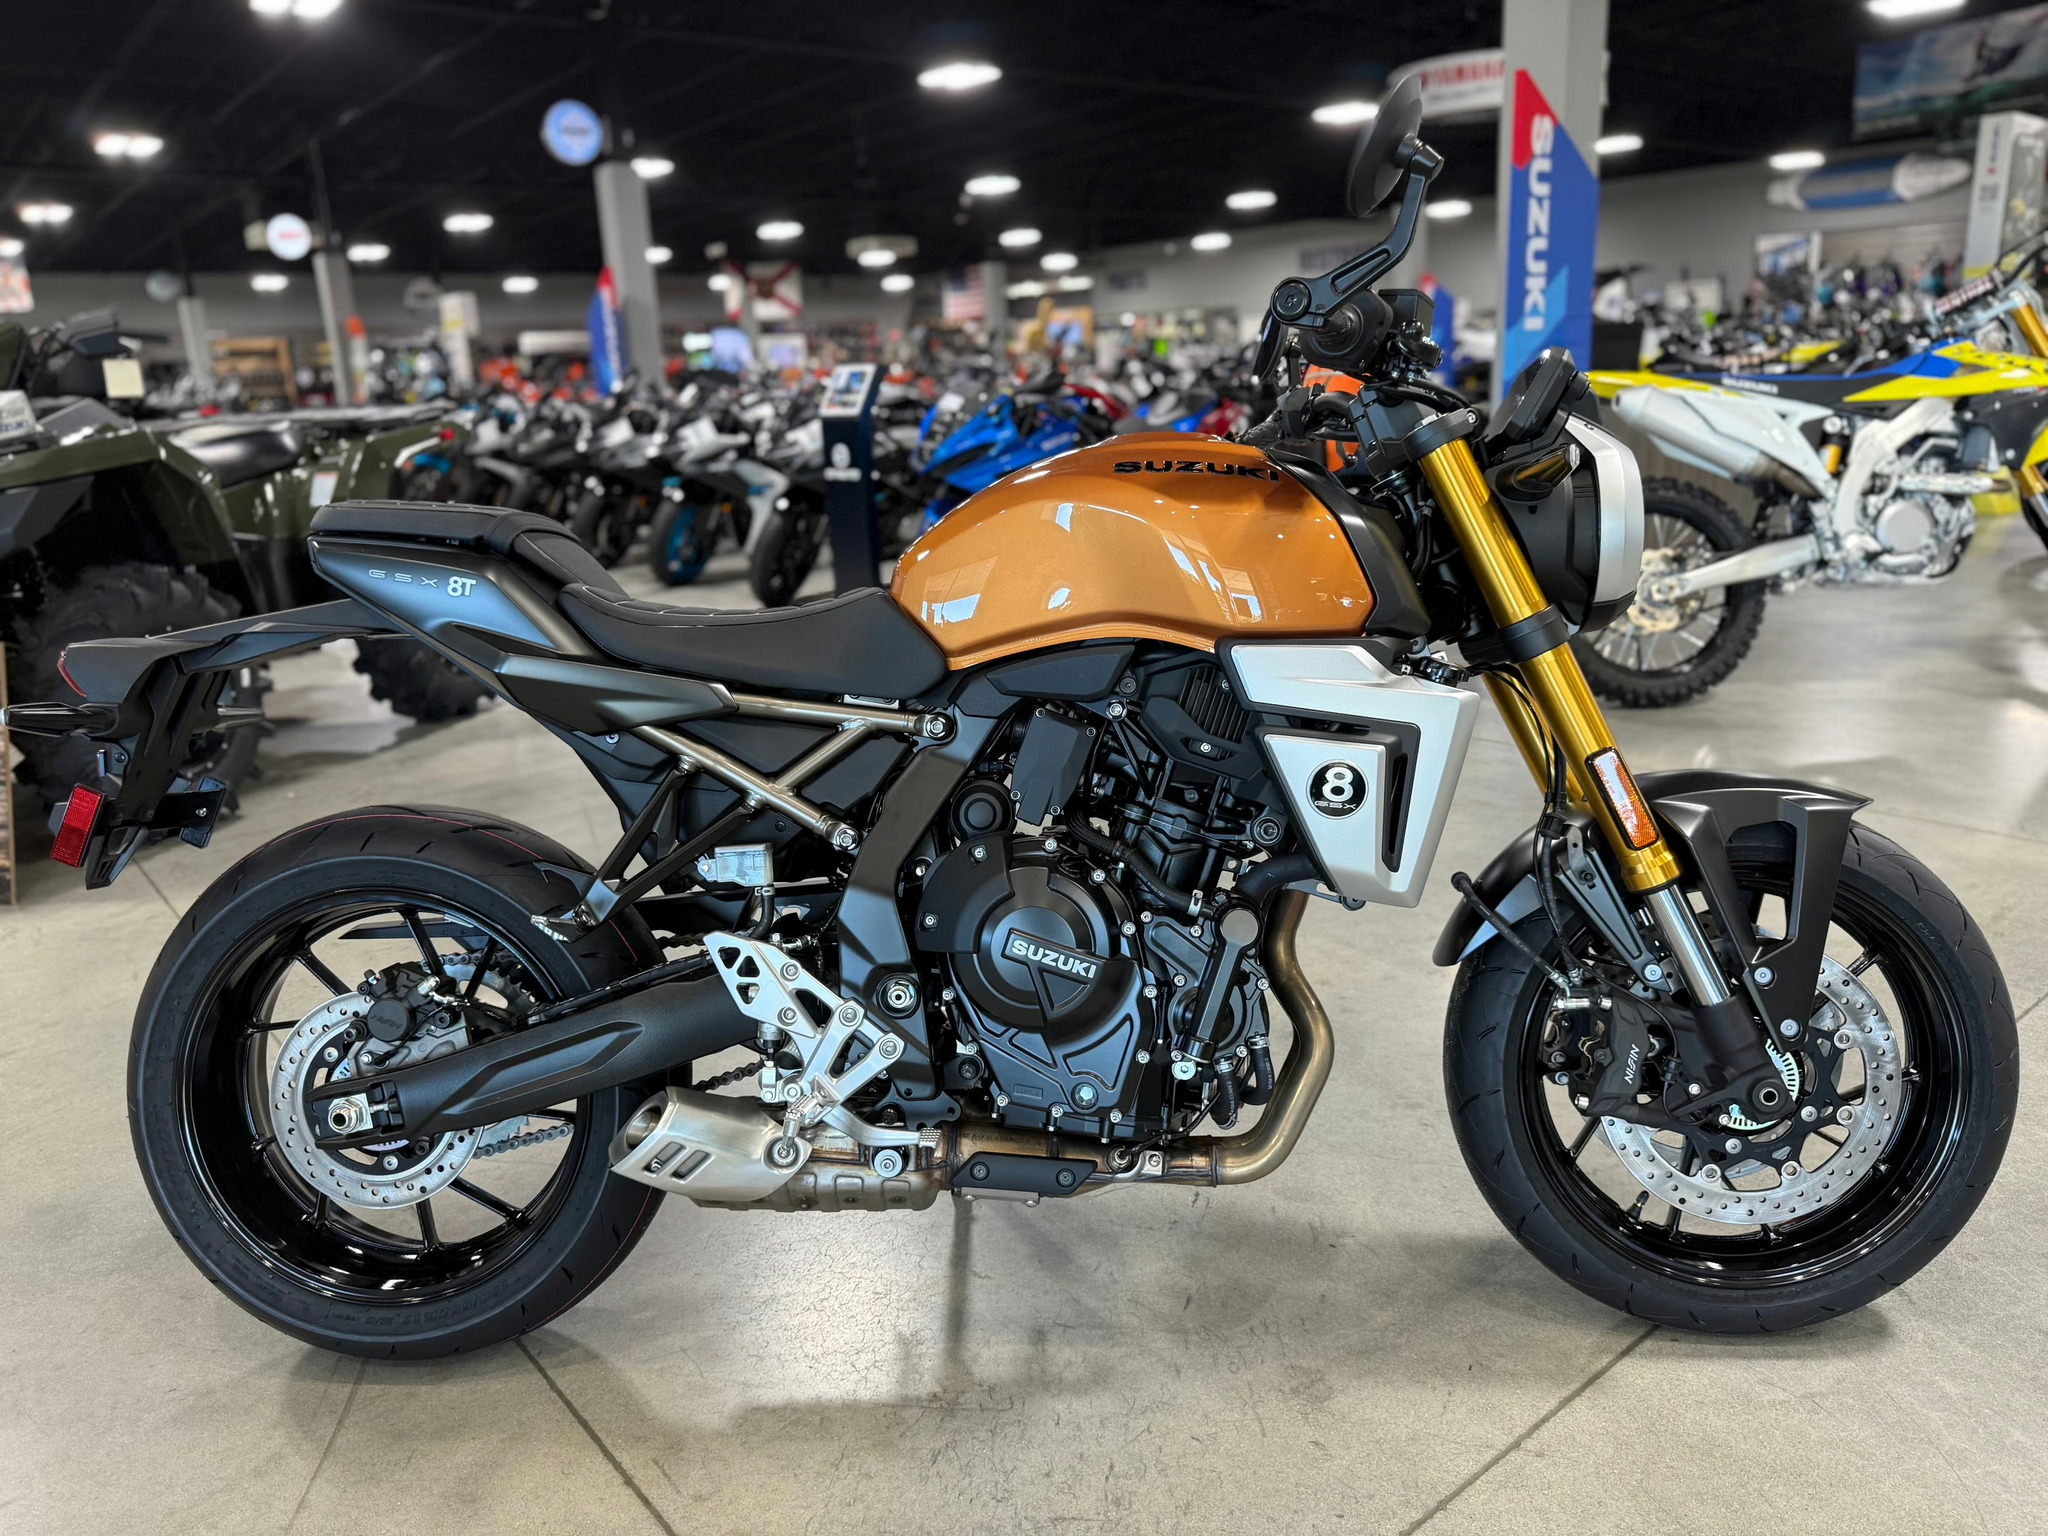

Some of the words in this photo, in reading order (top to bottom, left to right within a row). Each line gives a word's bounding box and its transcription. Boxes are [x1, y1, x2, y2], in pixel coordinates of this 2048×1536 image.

[1522, 113, 1554, 332] SUZUKI
[1113, 460, 1280, 483] SUZUKI
[368, 568, 439, 588] GSX
[447, 576, 477, 597] 8T
[1321, 766, 1354, 802] 8
[1314, 800, 1357, 810] GSX
[1011, 939, 1097, 979] SUZUKI
[1623, 1043, 1640, 1085] NISSIN
